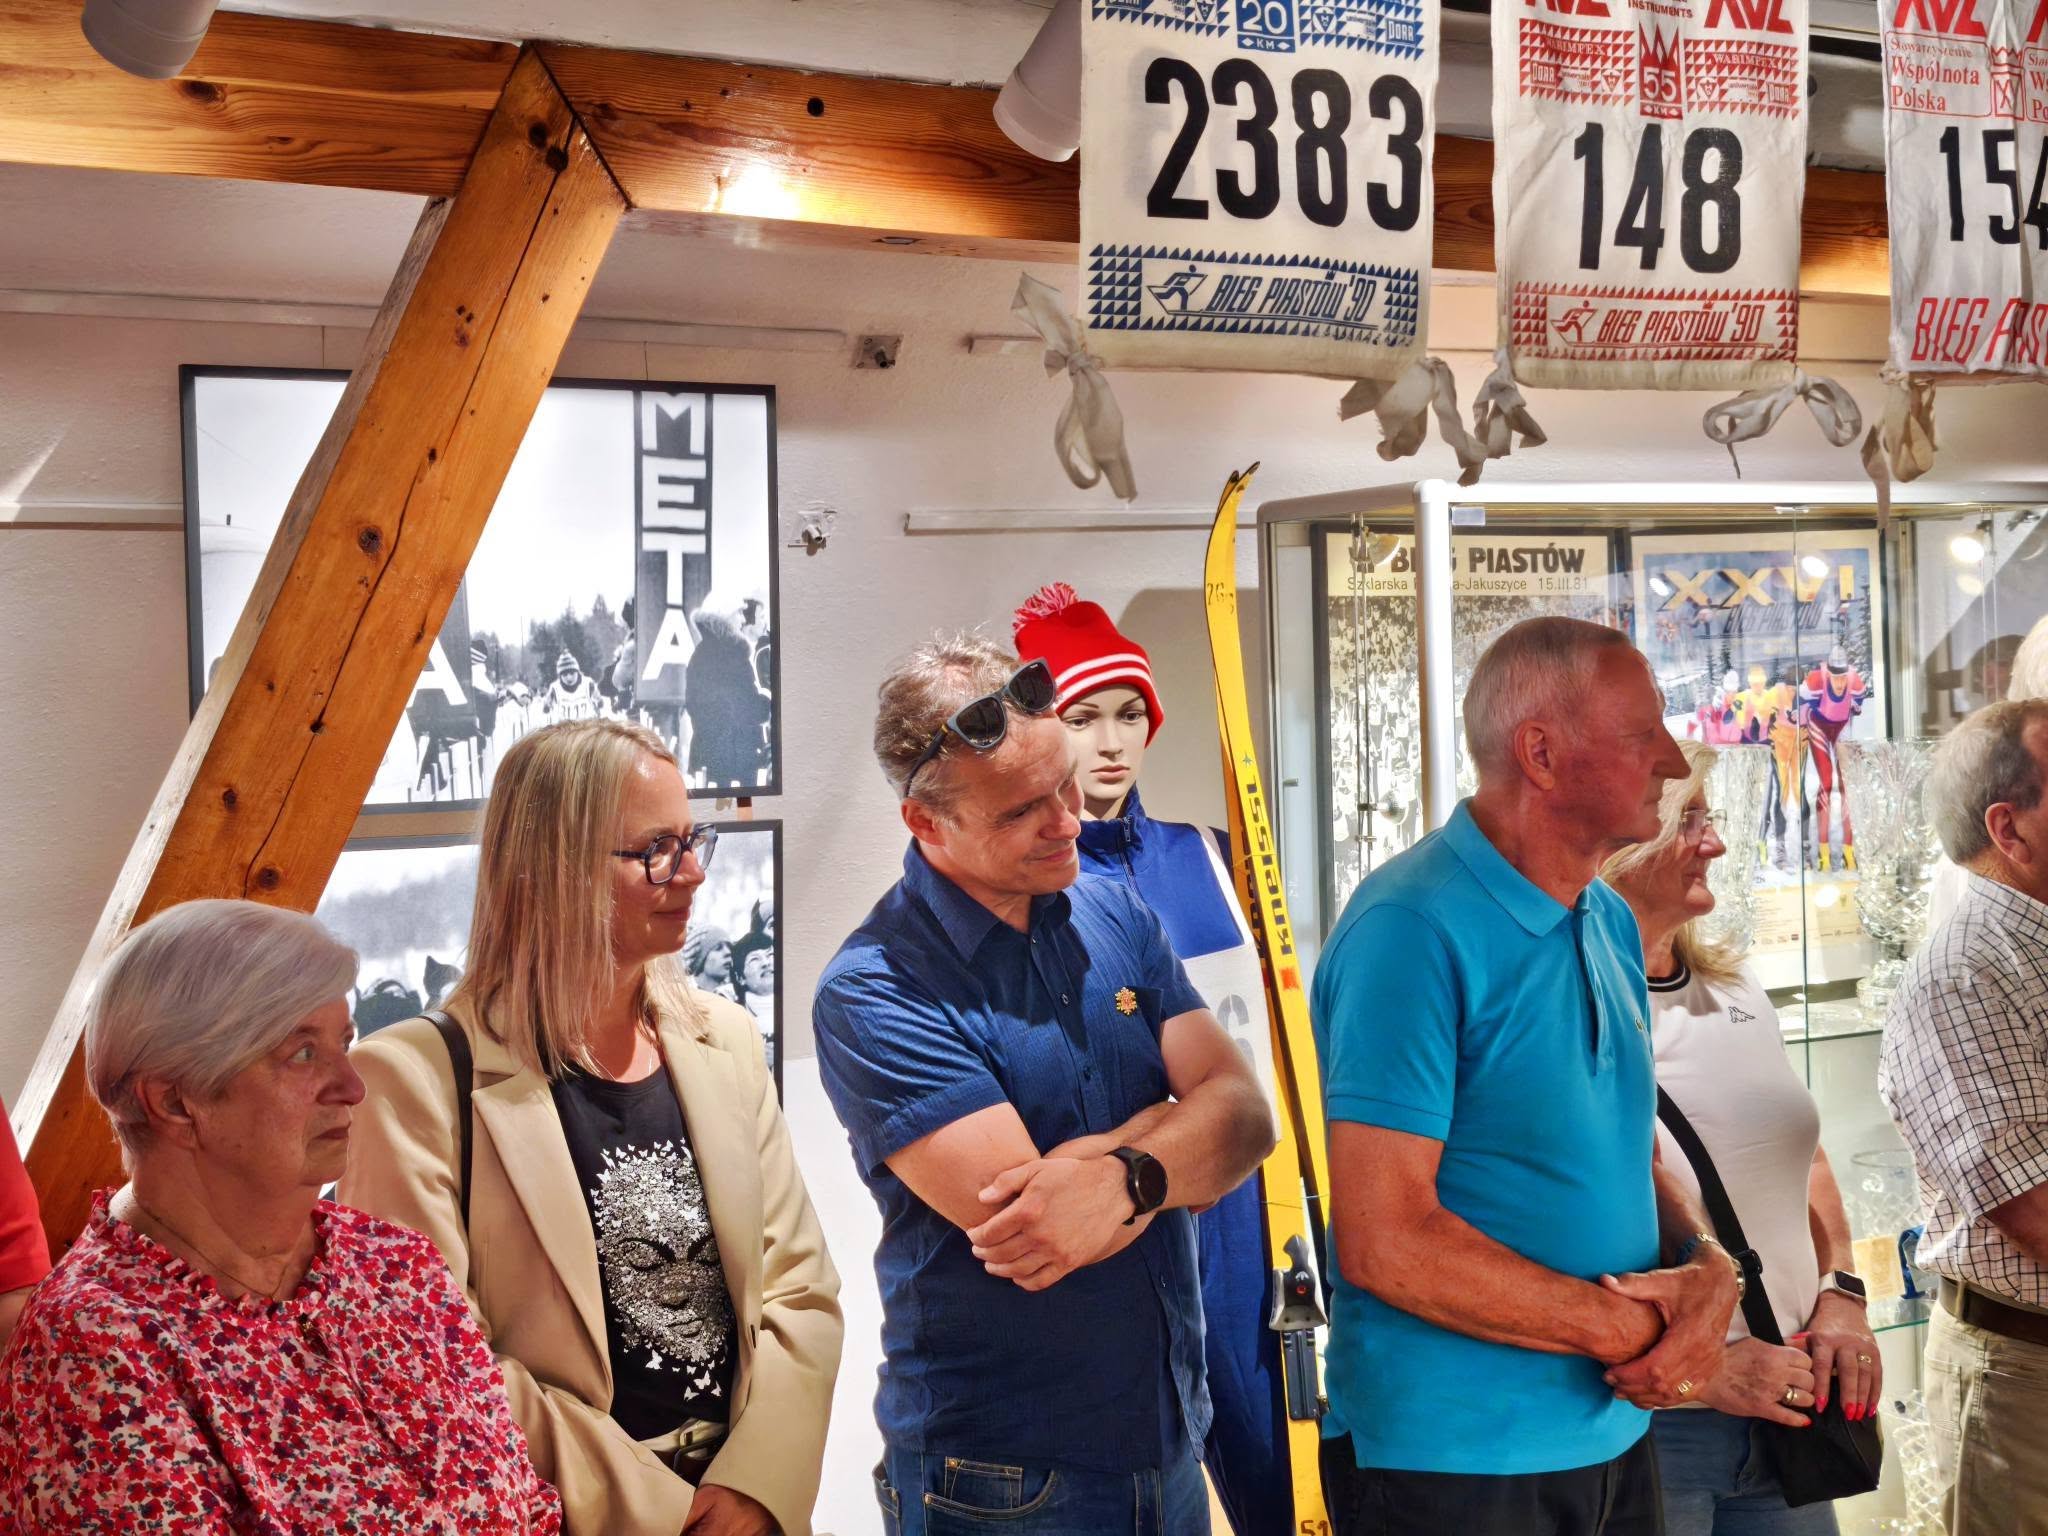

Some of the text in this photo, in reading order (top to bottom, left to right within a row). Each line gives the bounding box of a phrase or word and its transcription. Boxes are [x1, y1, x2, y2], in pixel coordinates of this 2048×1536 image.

[1241, 0, 1288, 34] 20
[1628, 0, 1693, 18] INSTRUMENTS
[1256, 38, 1275, 49] KM
[1643, 66, 1677, 103] 55
[1892, 55, 1980, 85] Wspólnota
[1891, 85, 1947, 112] Polska
[1145, 58, 1424, 231] 2383
[1574, 122, 1743, 273] 148
[1206, 274, 1262, 313] BIEG
[1597, 309, 1642, 343] BIEG
[1911, 297, 1990, 366] BIEG
[642, 390, 706, 680] META
[1468, 542, 1585, 573] PIASTÓW
